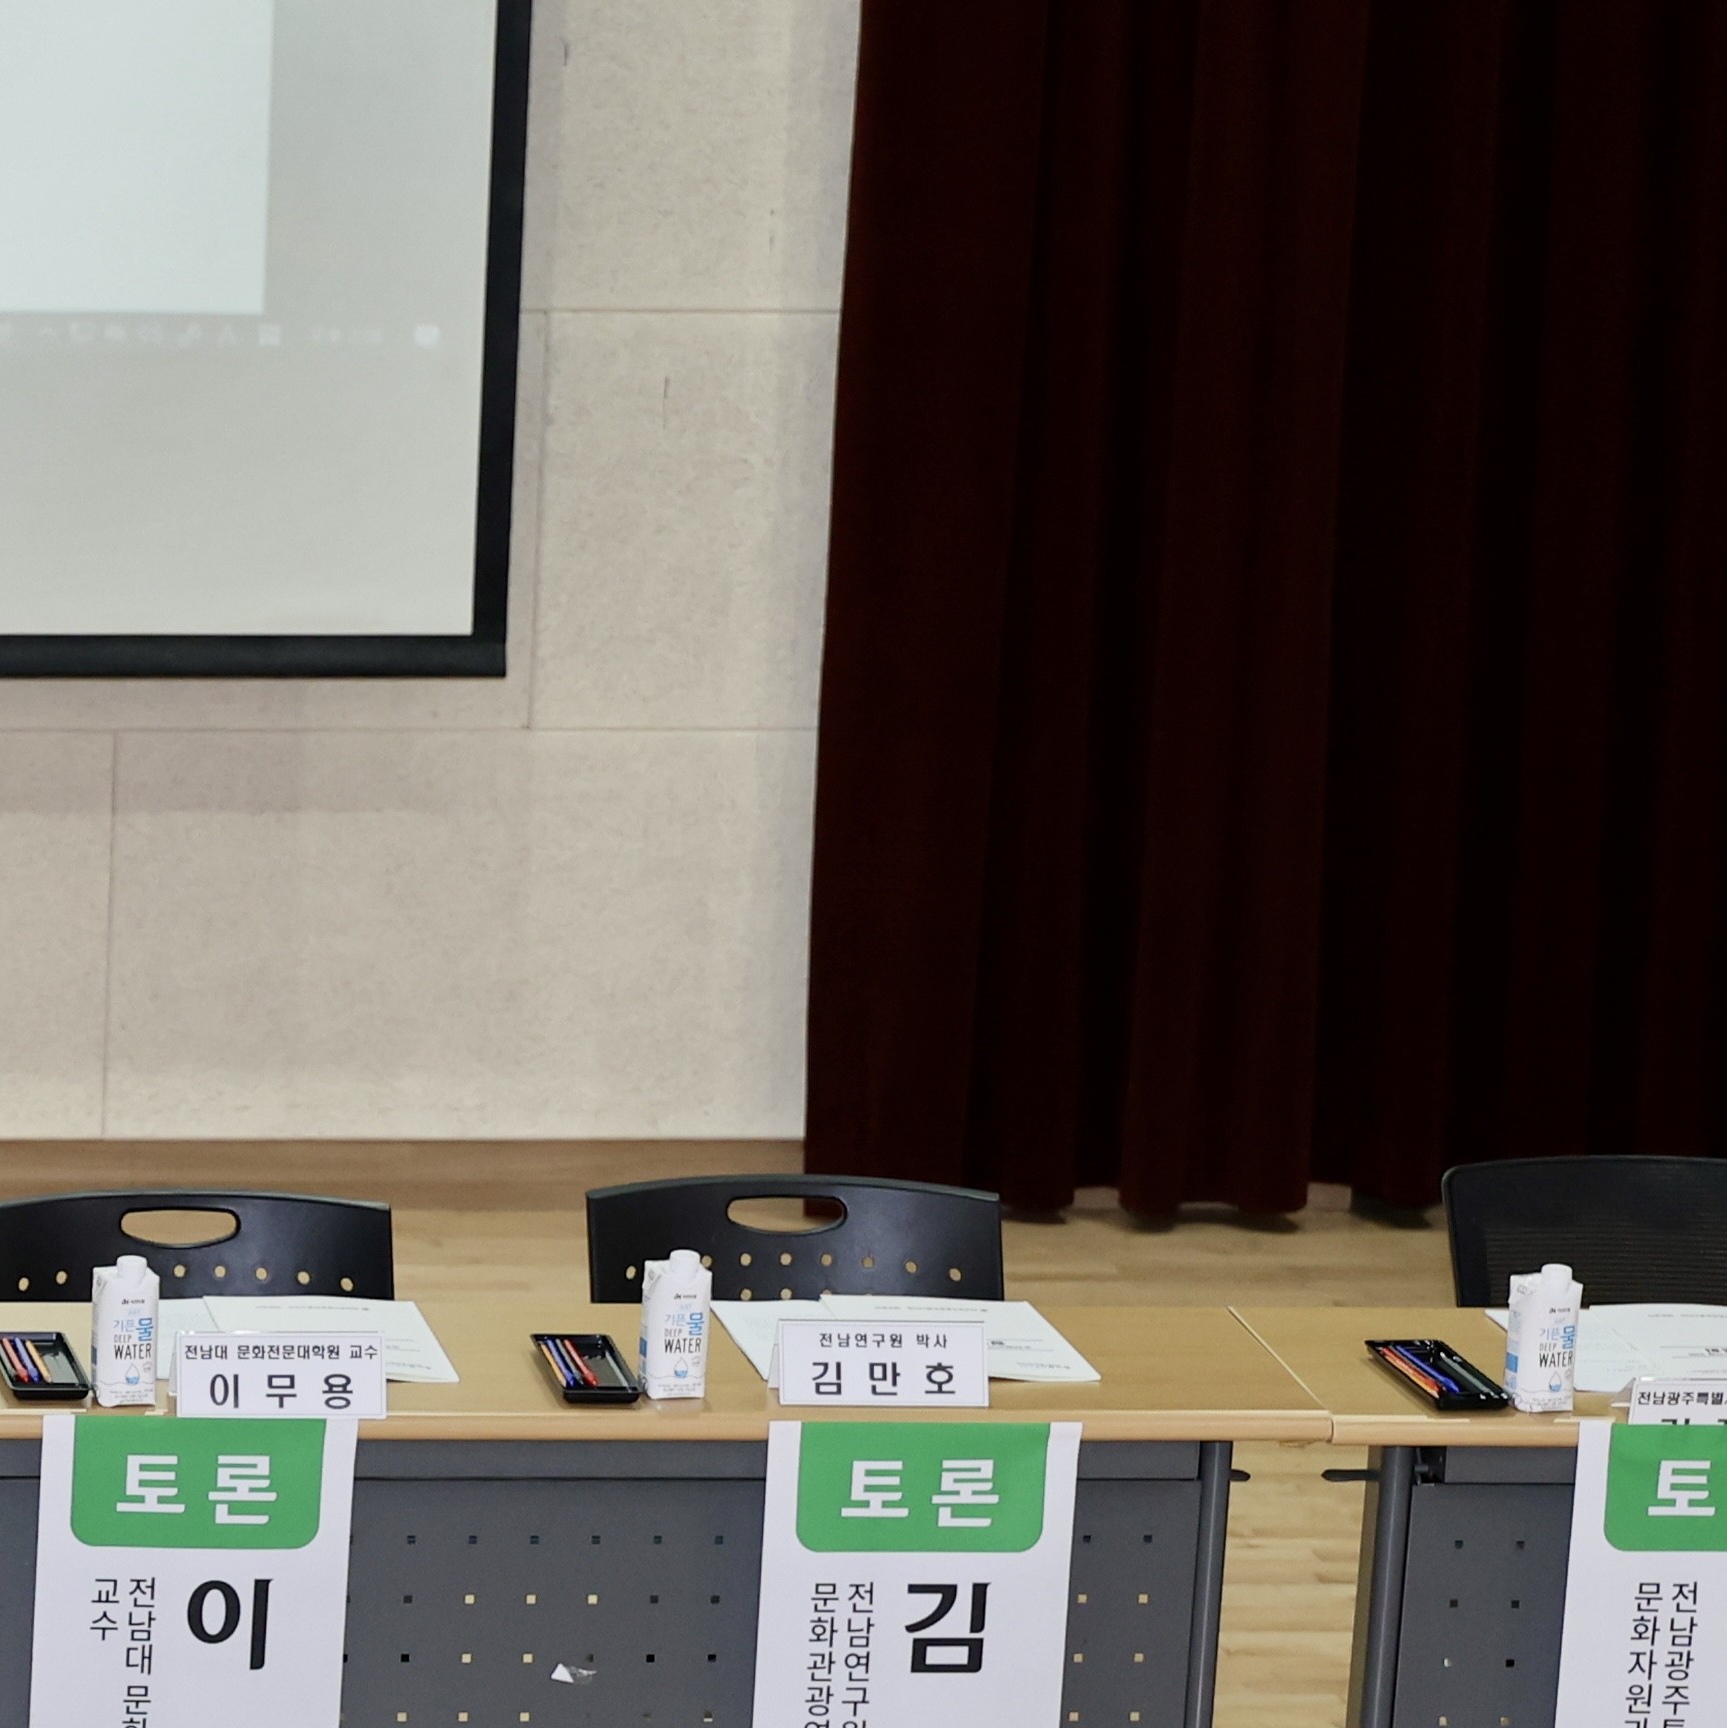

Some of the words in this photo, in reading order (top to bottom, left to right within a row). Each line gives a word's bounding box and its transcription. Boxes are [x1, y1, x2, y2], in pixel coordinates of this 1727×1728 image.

[113, 1334, 132, 1343] DEEP
[664, 1328, 683, 1337] DEEP
[664, 1338, 702, 1353] WATER
[819, 1333, 903, 1349] 전남연구원
[916, 1333, 947, 1349] 박사
[1539, 1342, 1557, 1351] DEEP
[113, 1344, 152, 1360] WATER
[184, 1344, 228, 1360] 전남대
[237, 1344, 340, 1360] 문화전문대학원
[349, 1344, 378, 1360] 교수
[1638, 1391, 1727, 1406] 전남광주특별
[89, 1578, 120, 1641] 교수
[124, 1576, 157, 1676] 전남대
